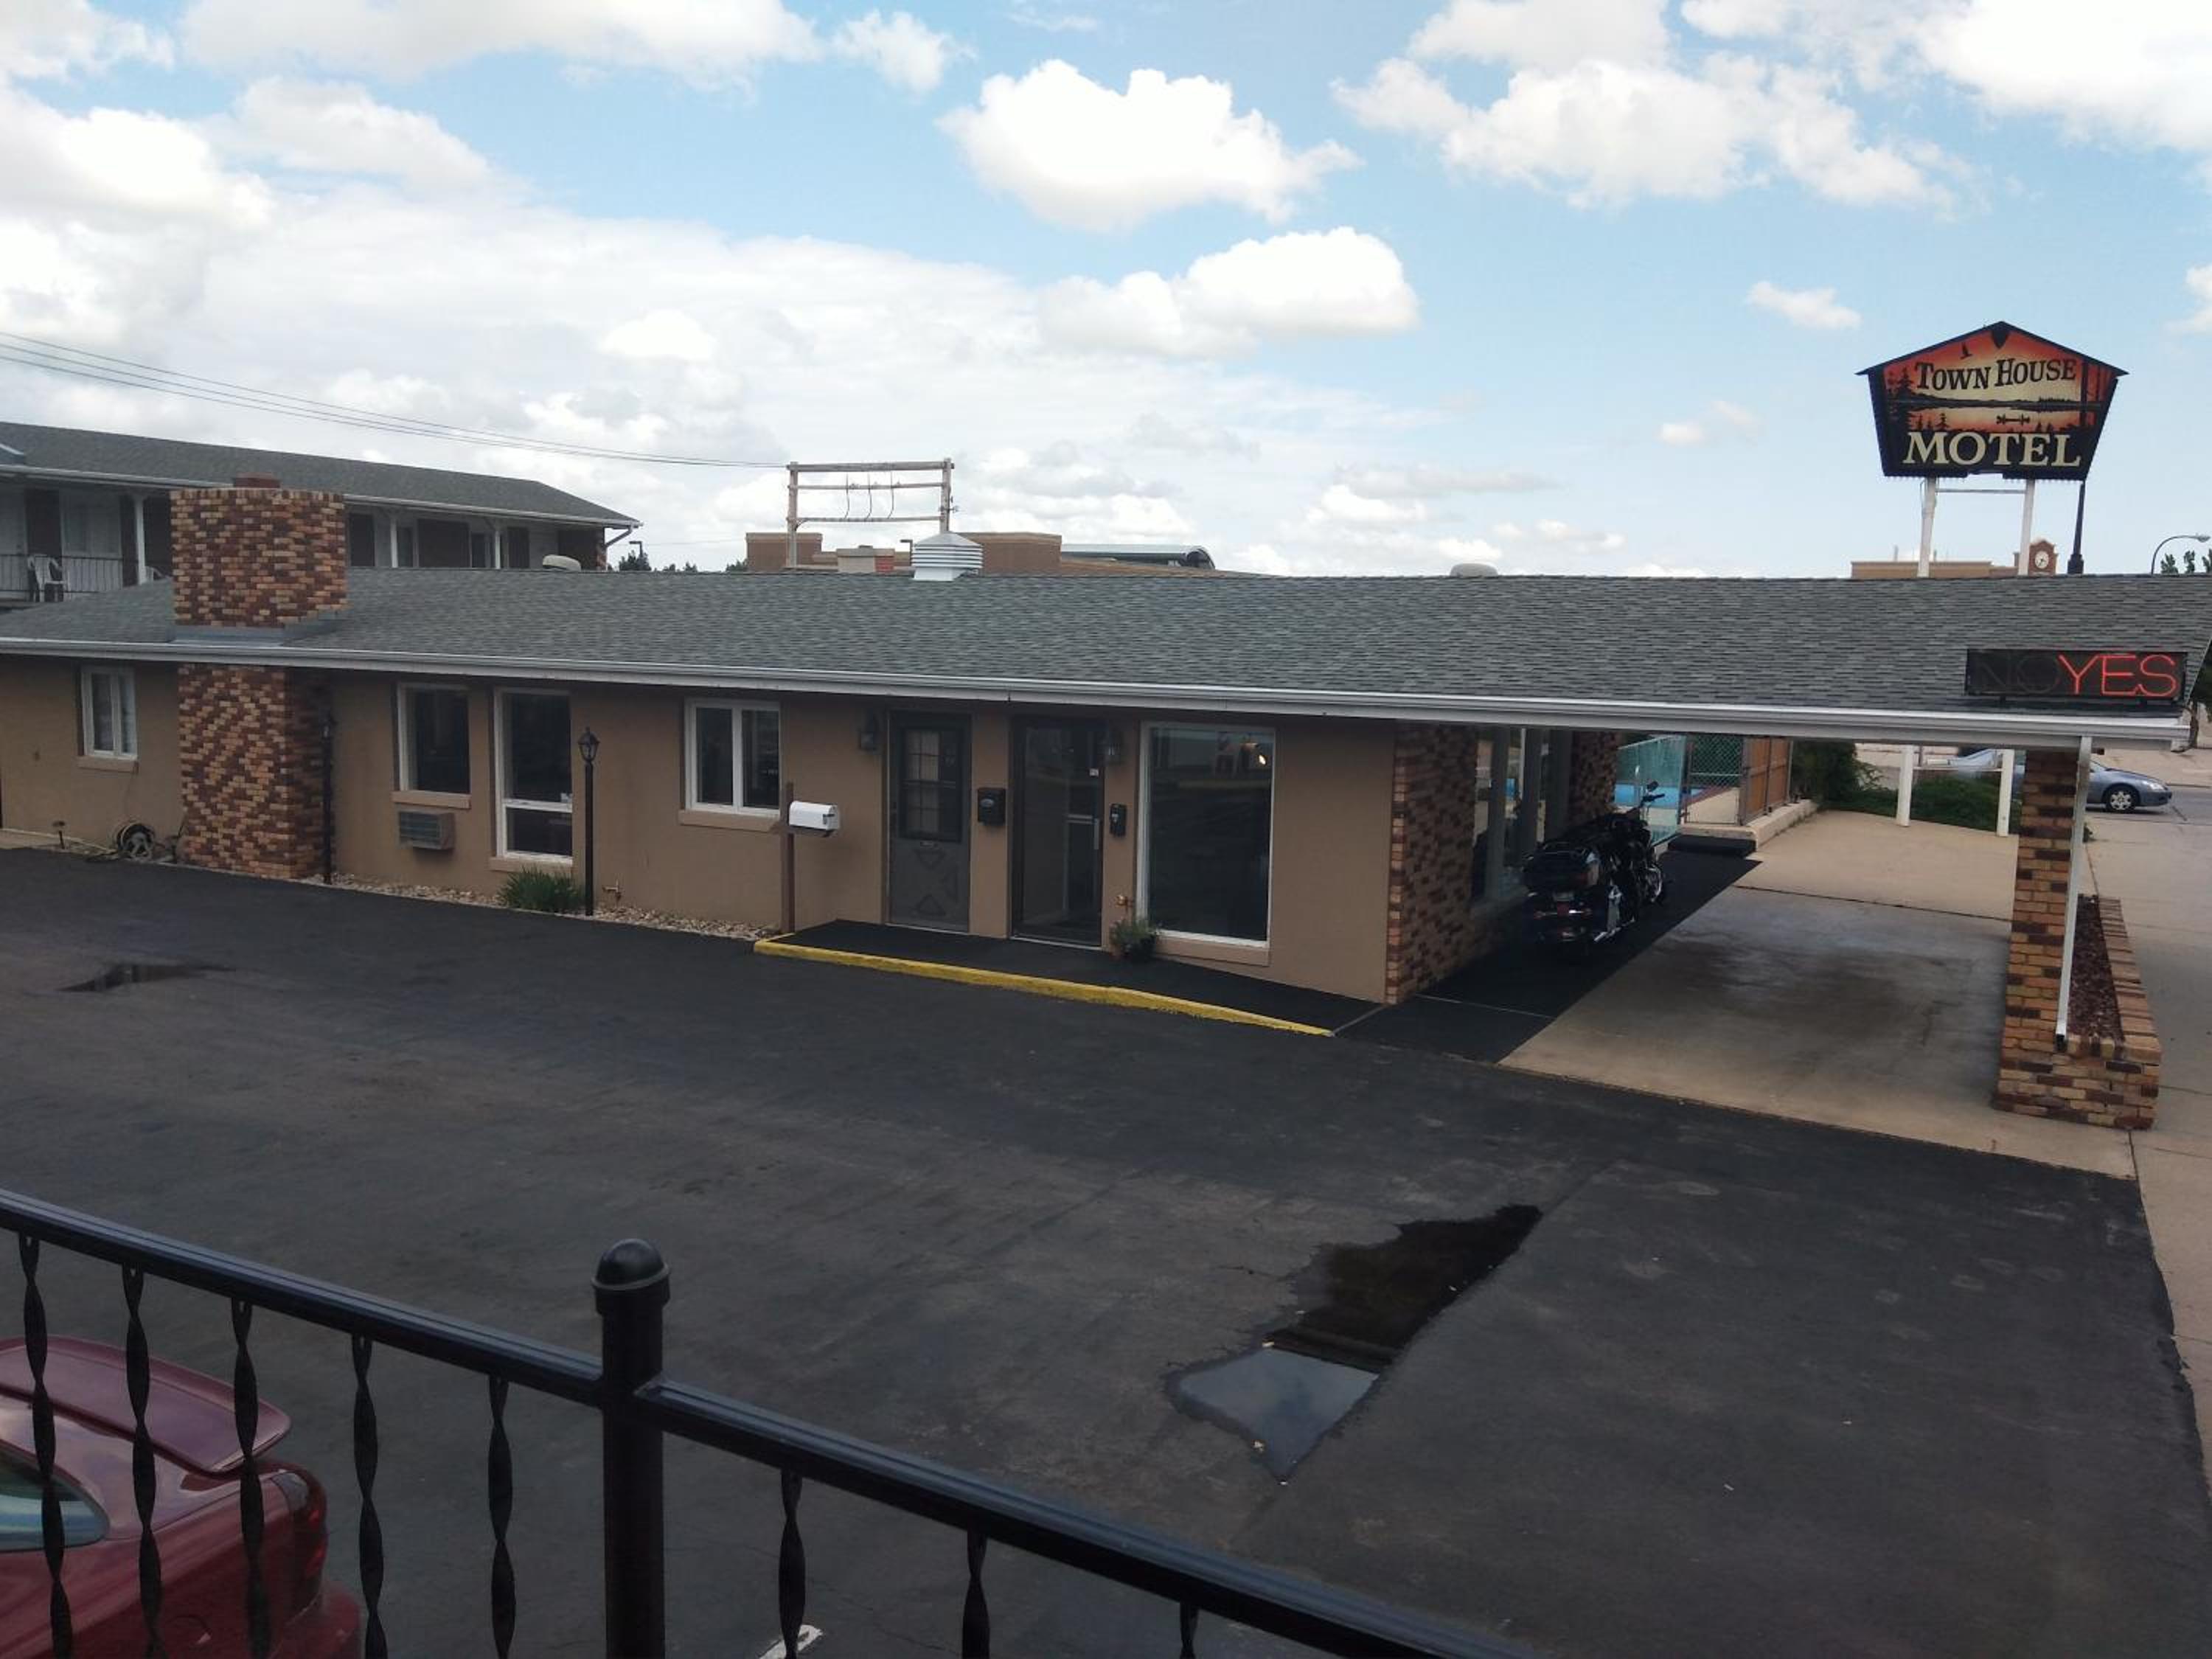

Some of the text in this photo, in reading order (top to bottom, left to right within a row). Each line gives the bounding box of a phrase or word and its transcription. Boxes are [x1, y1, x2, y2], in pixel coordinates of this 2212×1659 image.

[1915, 358, 2077, 391] TOWN HOUSE
[1902, 431, 2082, 467] MOTEL
[2058, 653, 2180, 697] YES
